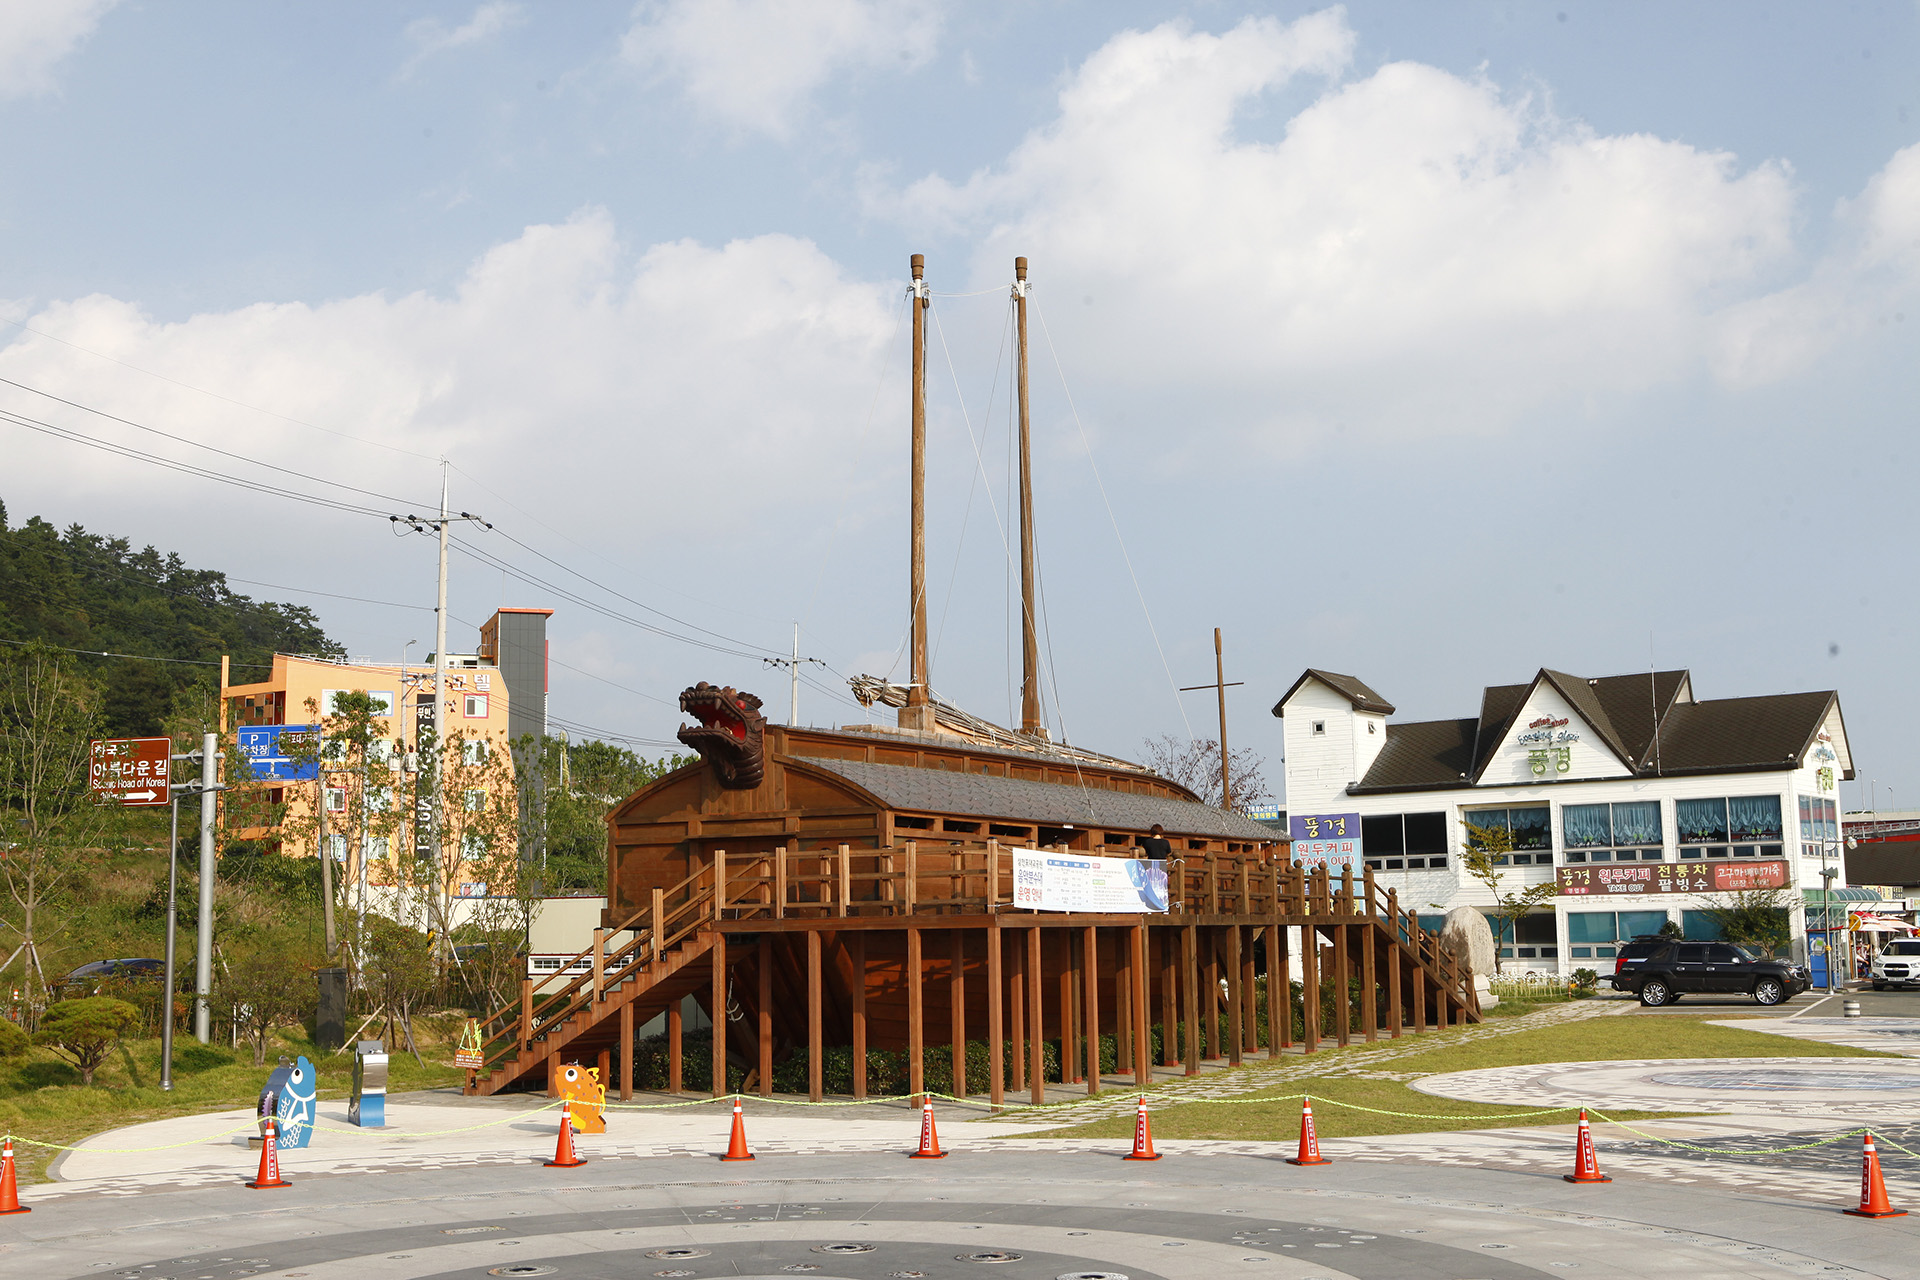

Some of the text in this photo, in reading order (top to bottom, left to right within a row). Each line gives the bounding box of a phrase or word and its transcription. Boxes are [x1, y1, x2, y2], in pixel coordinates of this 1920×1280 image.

[1529, 717, 1570, 729] coffee shop
[251, 734, 259, 745] P
[241, 745, 269, 756] 주차장
[154, 759, 167, 775] 길
[1528, 747, 1570, 775] 풍경
[117, 778, 136, 788] Road
[136, 777, 145, 787] of
[145, 777, 167, 787] Korea
[1304, 817, 1346, 838] 풍경
[1297, 842, 1354, 856] 원두커피
[1330, 855, 1355, 866] OUT)
[1562, 869, 1590, 886] 풍경
[1598, 868, 1651, 885] 원두커피
[1657, 864, 1708, 878] 전통차
[1607, 883, 1645, 892] TAKE OUT
[1658, 878, 1709, 891] 팥빙수
